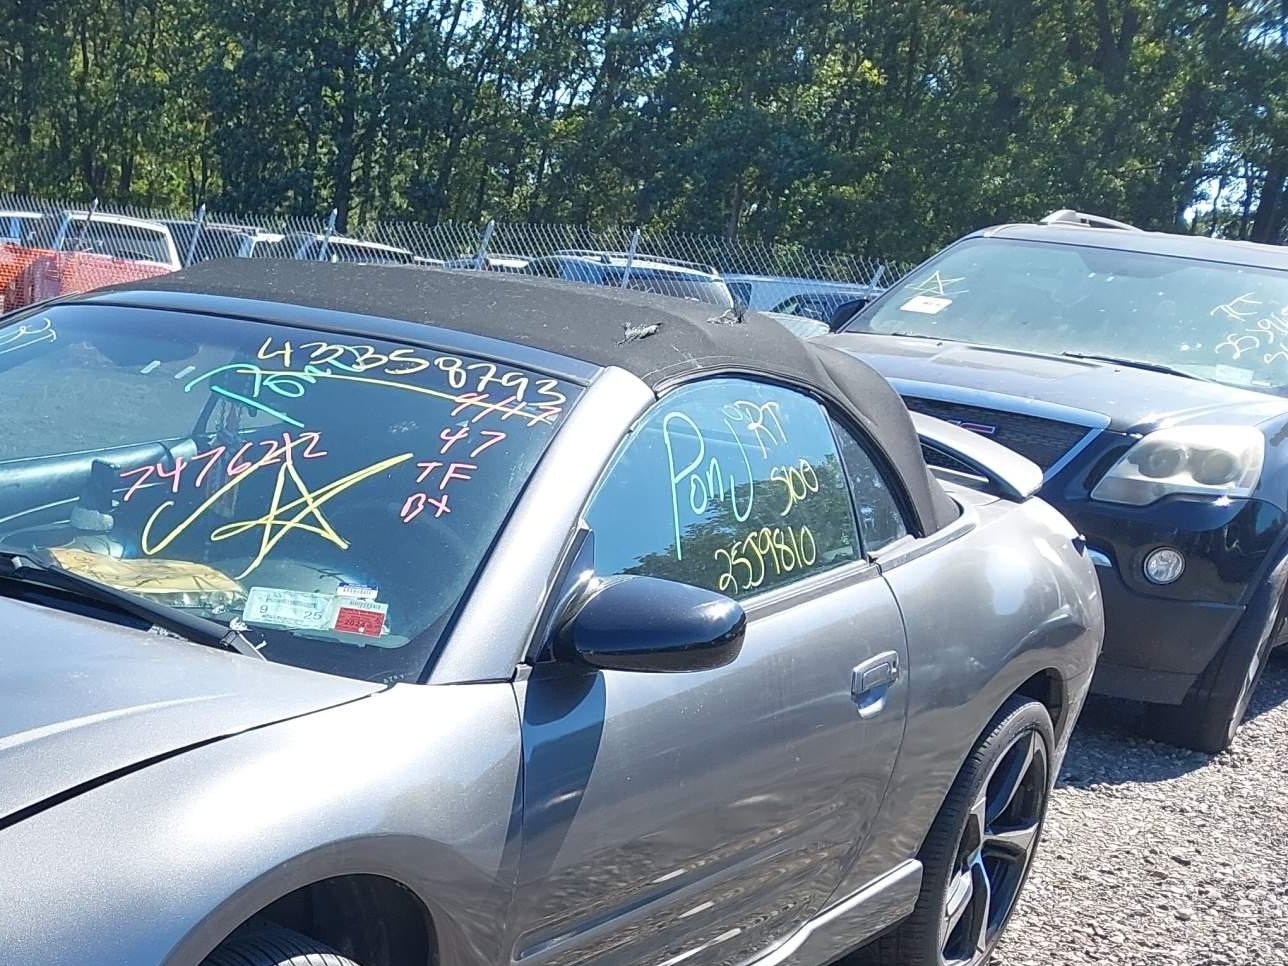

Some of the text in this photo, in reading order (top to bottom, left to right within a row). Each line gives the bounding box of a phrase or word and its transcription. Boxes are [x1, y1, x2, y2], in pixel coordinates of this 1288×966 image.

[257, 335, 568, 407] 43358793
[416, 462, 478, 490] TF
[303, 610, 323, 620] 25
